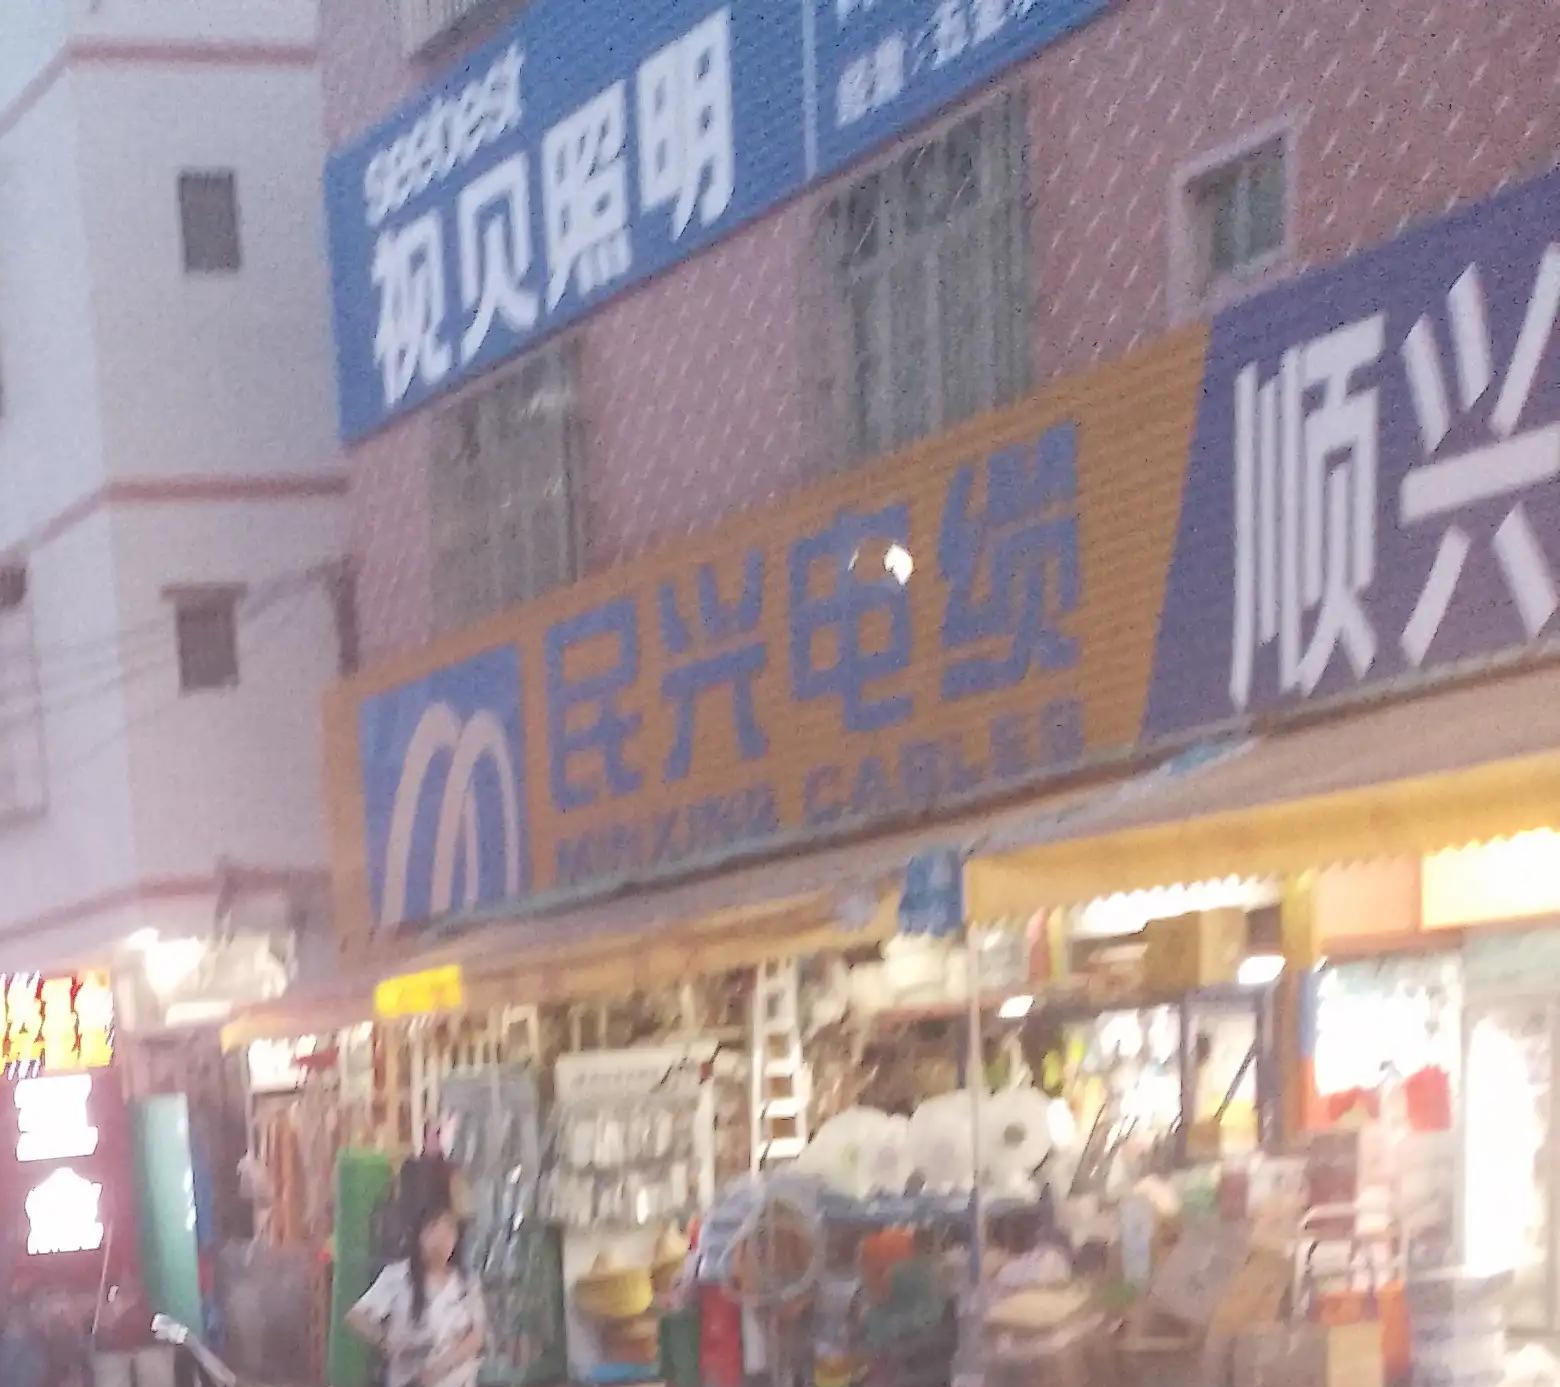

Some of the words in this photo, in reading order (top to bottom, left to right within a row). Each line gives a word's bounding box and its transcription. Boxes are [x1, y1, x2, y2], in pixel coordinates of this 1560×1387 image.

[371, 5, 735, 409] 视贝照明
[544, 420, 1081, 811] 民兴电缆
[1229, 242, 1560, 709] 顺兴
